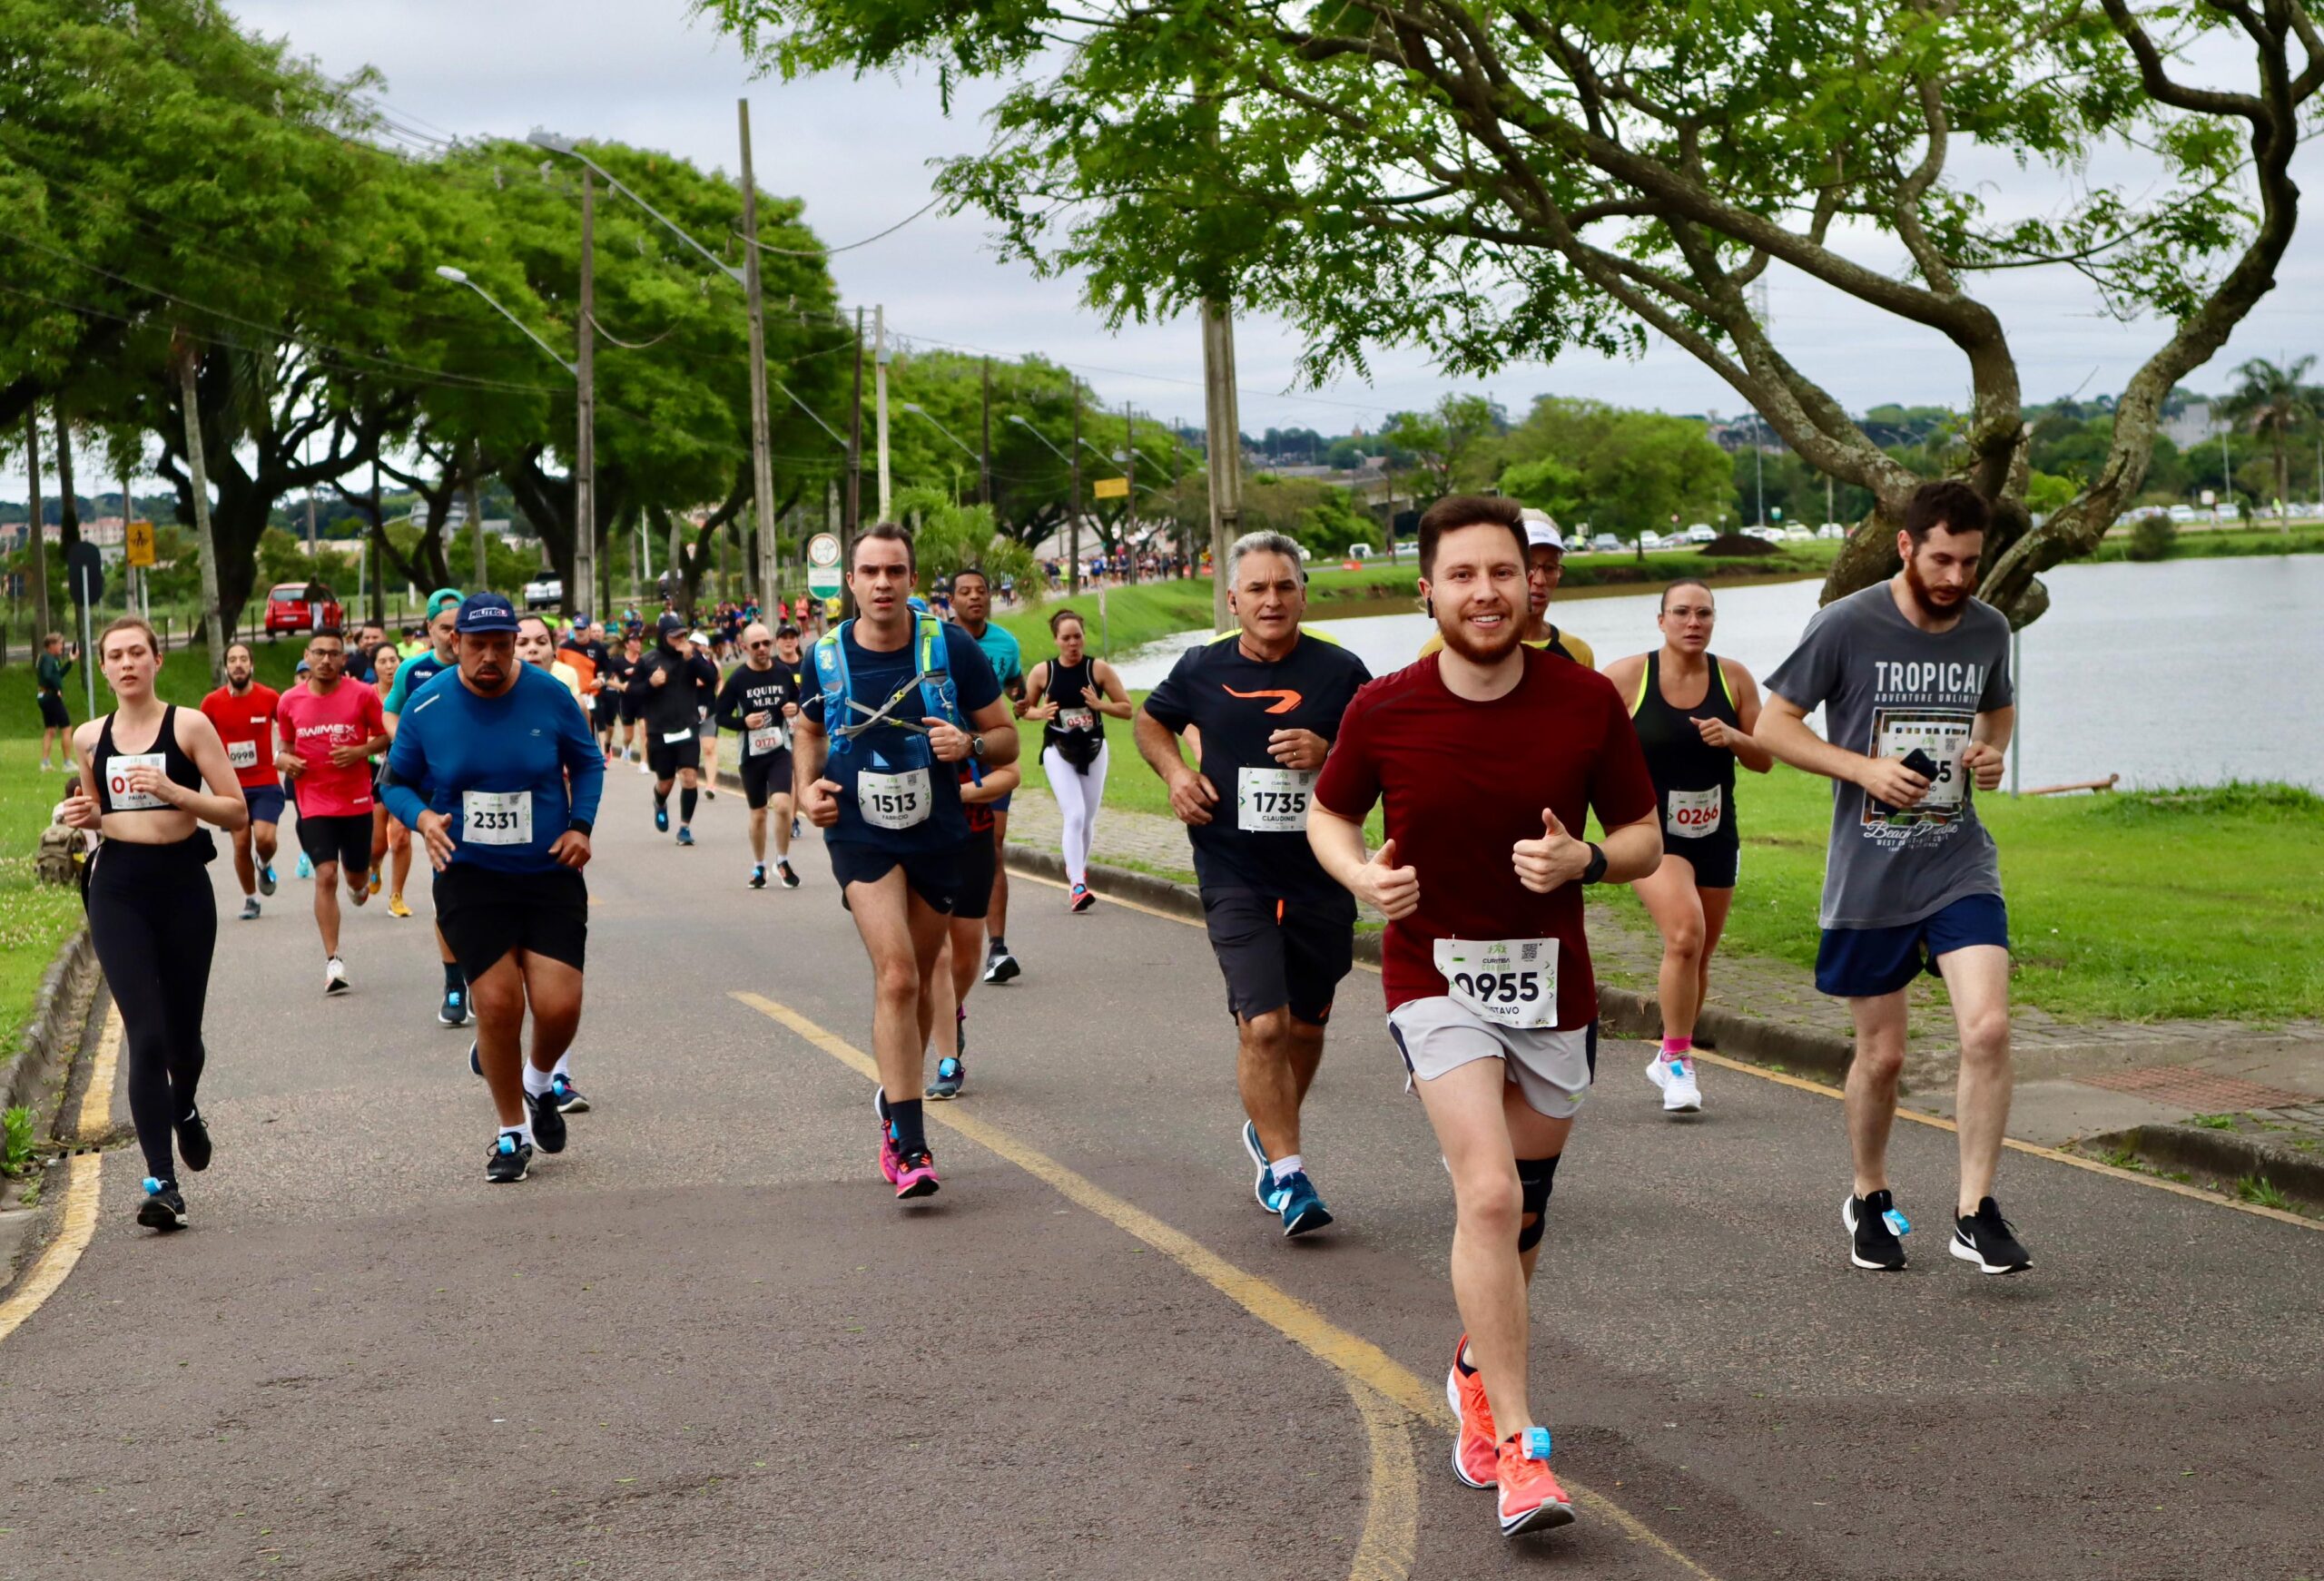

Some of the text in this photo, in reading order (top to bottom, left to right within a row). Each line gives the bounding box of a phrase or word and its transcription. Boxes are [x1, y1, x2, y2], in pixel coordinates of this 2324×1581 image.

[1875, 661, 1984, 695] TROPICAL
[746, 684, 784, 699] EQUIPE
[1874, 692, 1933, 702] ADVENTURE
[230, 751, 255, 761] 0998
[872, 791, 917, 813] 1513
[1253, 791, 1306, 814] 1735
[473, 810, 518, 830] 2331
[1676, 803, 1719, 825] 0266
[1453, 971, 1540, 1003] 0955
